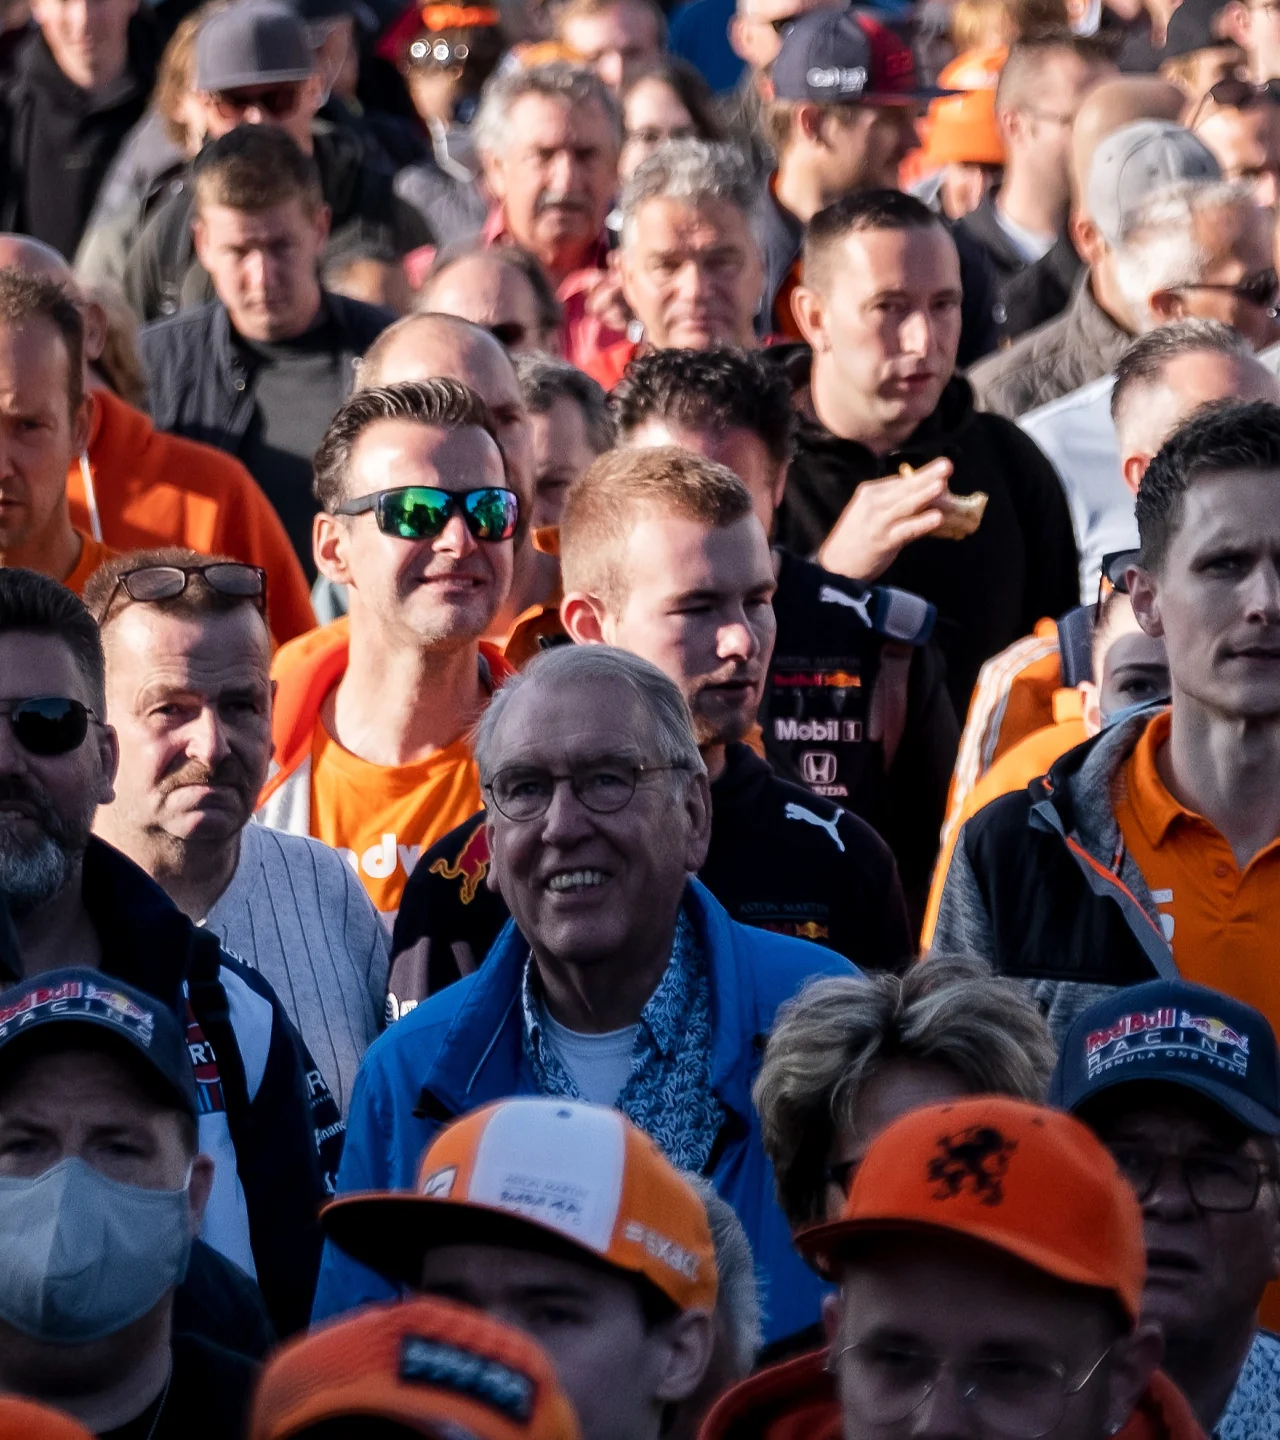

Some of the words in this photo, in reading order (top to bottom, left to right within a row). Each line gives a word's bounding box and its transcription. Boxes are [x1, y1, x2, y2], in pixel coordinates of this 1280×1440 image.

[773, 716, 840, 741] Mobil
[1086, 1015, 1130, 1056] Red
[1127, 1008, 1177, 1035] Bull
[1088, 1030, 1249, 1074] RACING
[1088, 1051, 1156, 1081] FORMULA
[1166, 1050, 1199, 1060] ONE
